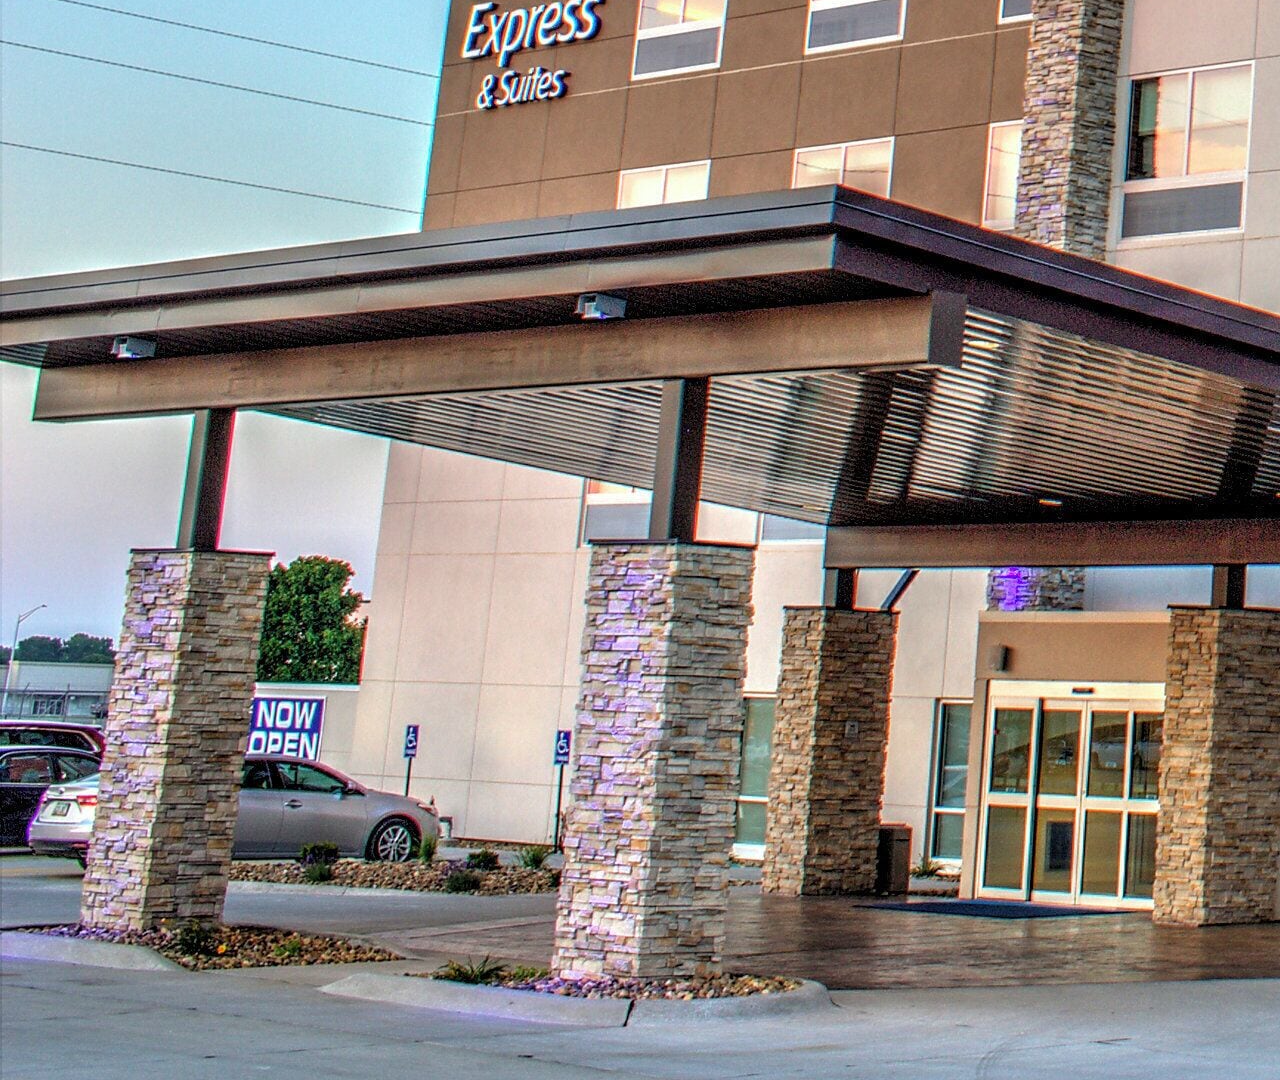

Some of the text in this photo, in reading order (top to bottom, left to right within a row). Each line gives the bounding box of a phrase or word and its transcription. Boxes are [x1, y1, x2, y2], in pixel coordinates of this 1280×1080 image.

[476, 67, 568, 109] & Suites
[256, 700, 318, 729] NOW
[247, 730, 319, 760] OPEN
